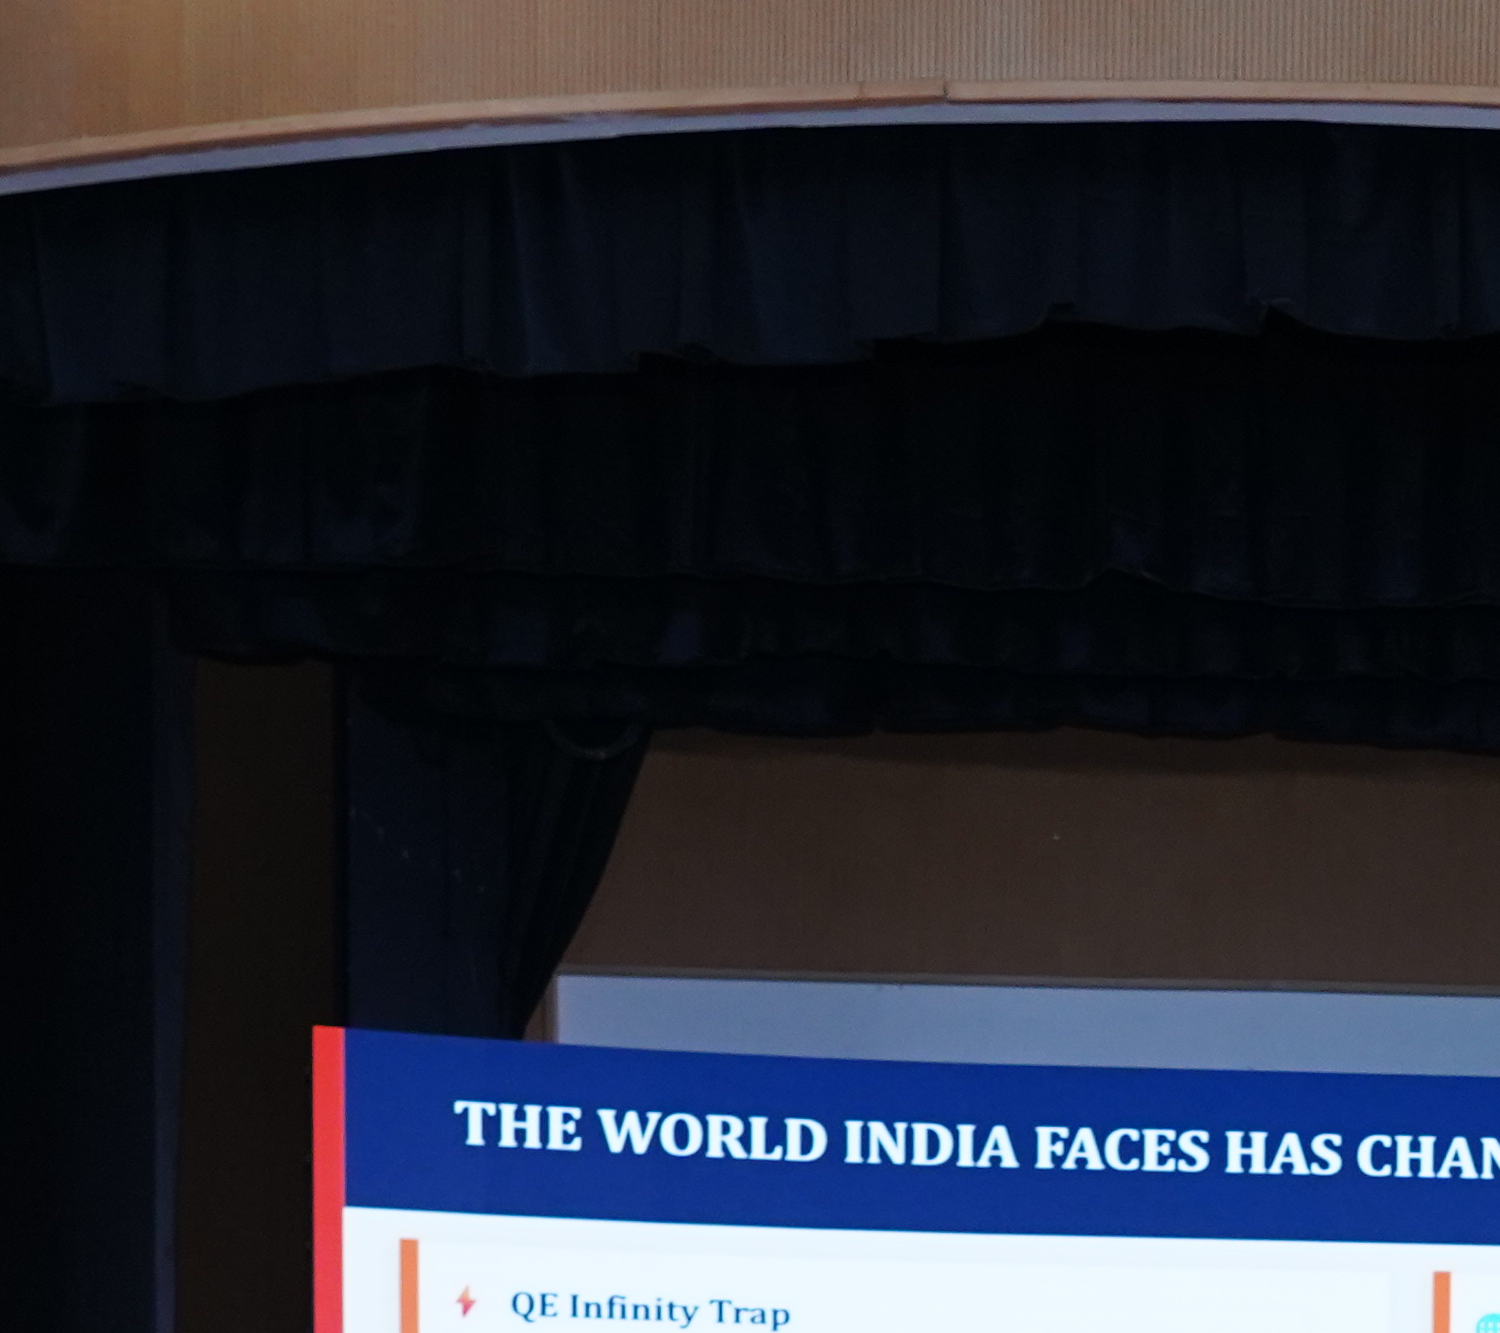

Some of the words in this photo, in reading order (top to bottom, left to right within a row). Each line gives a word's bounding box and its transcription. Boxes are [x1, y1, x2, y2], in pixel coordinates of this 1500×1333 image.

[453, 1099, 583, 1152] THE
[596, 1108, 828, 1162] WORLD
[844, 1119, 1020, 1169] INDIA
[1034, 1125, 1210, 1173] FACES
[1224, 1130, 1343, 1176] HAS
[511, 1292, 558, 1323] QE
[570, 1293, 699, 1329] Infinity
[709, 1299, 791, 1332] Trap
